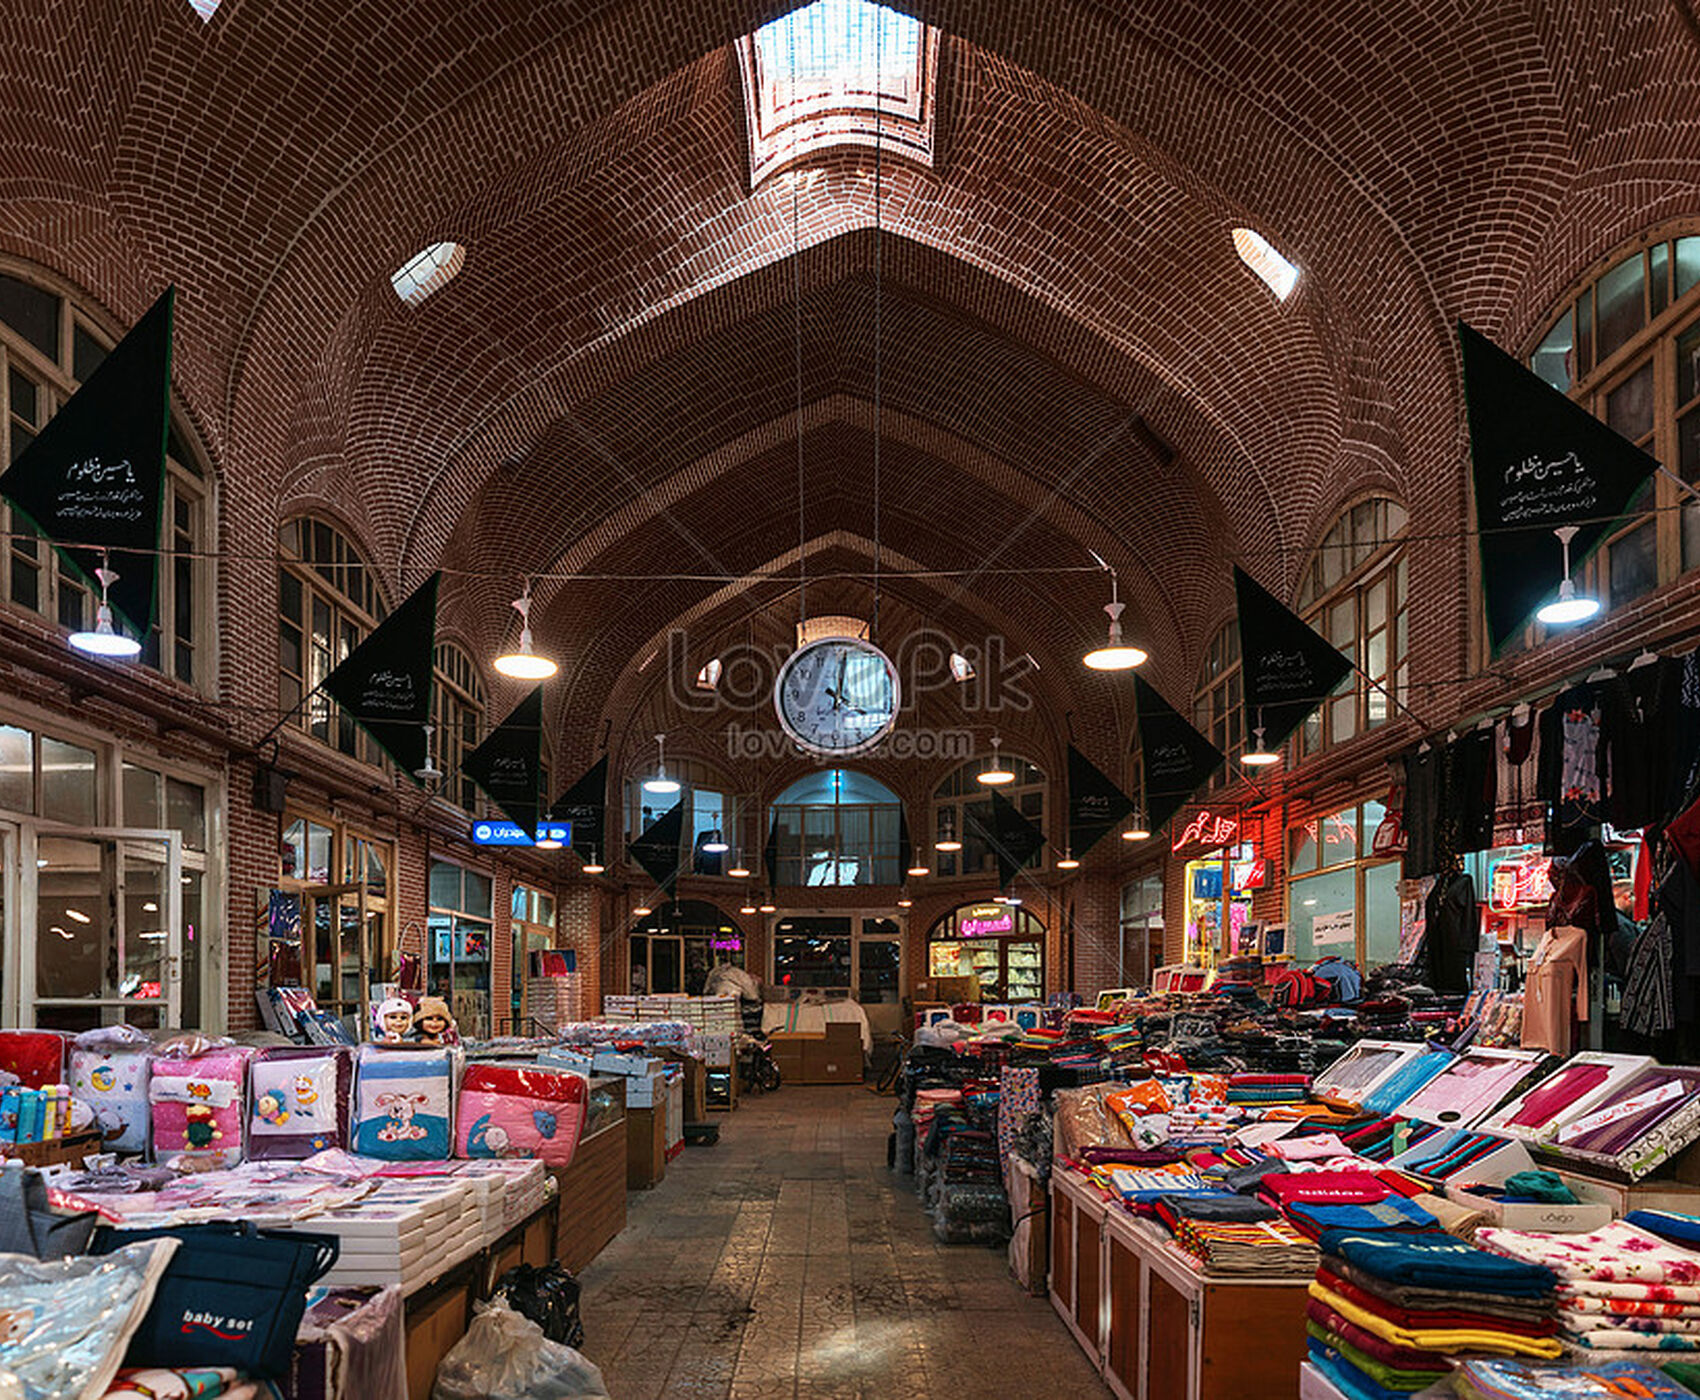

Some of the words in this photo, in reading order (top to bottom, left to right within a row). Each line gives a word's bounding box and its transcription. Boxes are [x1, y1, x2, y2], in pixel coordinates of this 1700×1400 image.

[1504, 455, 1543, 485] مظلوم
[797, 711, 806, 723] 8
[811, 723, 819, 734] 7
[183, 1309, 224, 1328] baby
[226, 1318, 253, 1331] set
